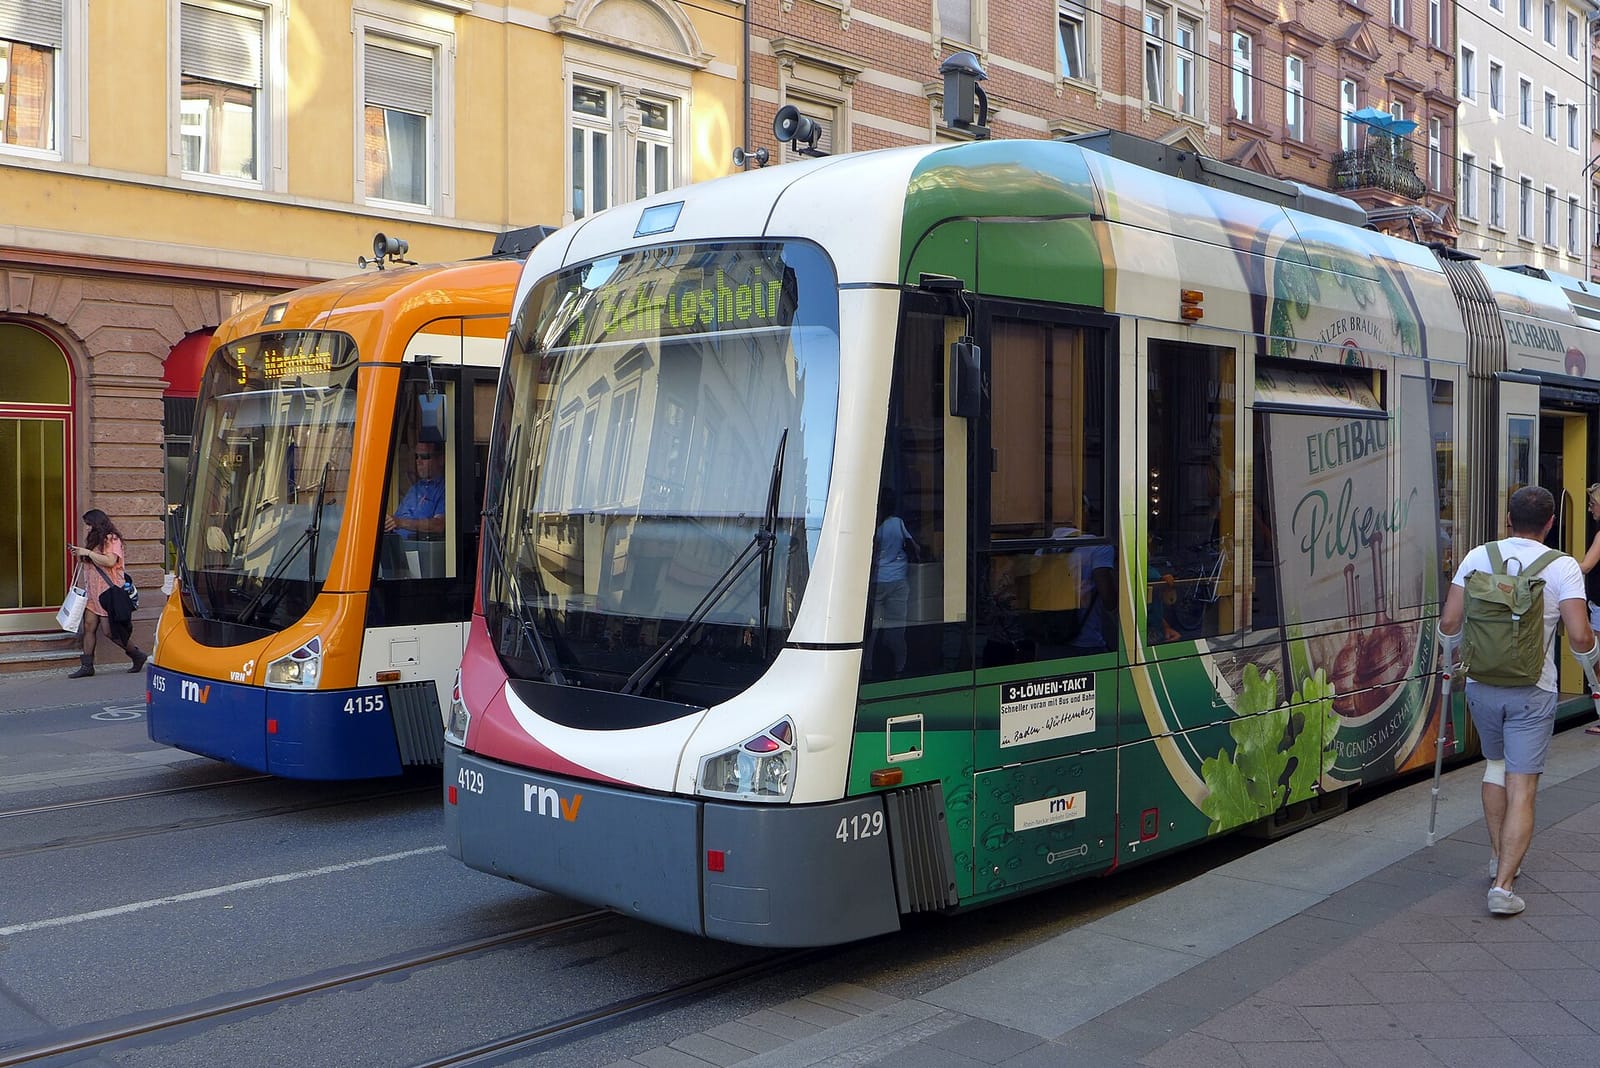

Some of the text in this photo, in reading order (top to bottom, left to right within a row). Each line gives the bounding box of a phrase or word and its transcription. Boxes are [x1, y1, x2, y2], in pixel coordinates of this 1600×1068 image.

[1504, 319, 1566, 354] EICHBAUM
[152, 674, 166, 692] 4155
[230, 671, 246, 682] VRN
[1009, 677, 1088, 700] 3-LÖWEN-TAKT
[181, 679, 211, 704] rnv
[343, 694, 384, 714] 4155
[1000, 703, 1028, 714] Schneller
[1030, 701, 1047, 710] voran
[1047, 699, 1058, 707] mit
[1058, 697, 1069, 706] Bus
[1070, 695, 1081, 703] und
[1346, 732, 1377, 758] GENUSS
[457, 766, 485, 795] 4129
[523, 782, 584, 822] rnv
[1050, 796, 1075, 813] rnv
[835, 810, 884, 844] 4129
